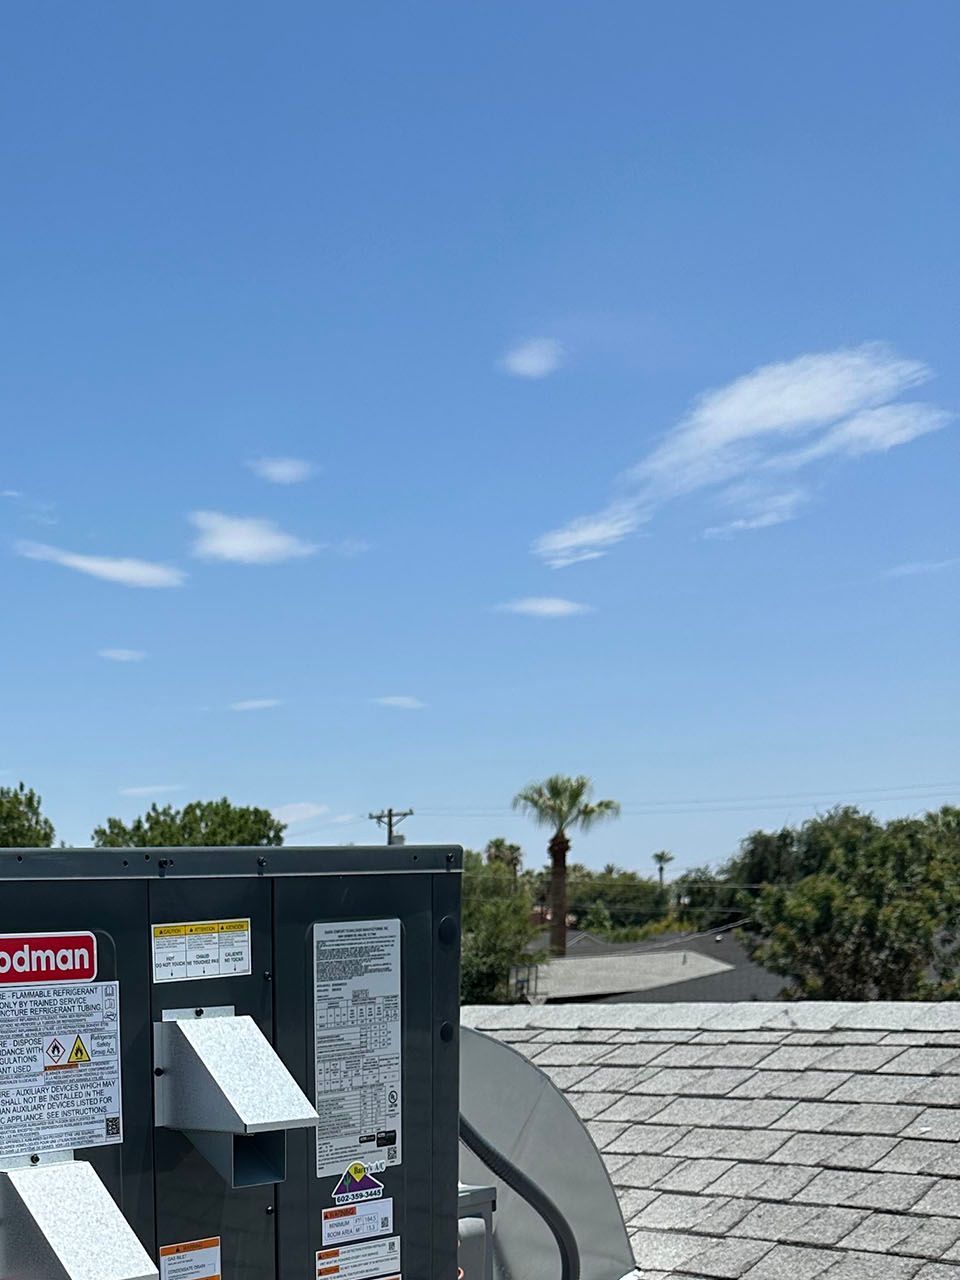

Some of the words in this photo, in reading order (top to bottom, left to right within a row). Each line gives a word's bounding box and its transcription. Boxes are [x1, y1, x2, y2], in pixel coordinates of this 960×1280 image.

[11, 989, 51, 999] FLAMMABLE
[52, 987, 97, 996] REFRIGERANT
[19, 1000, 28, 1008] BY
[30, 998, 58, 1007] TRAINED
[59, 996, 86, 1005] SERVICE
[29, 1005, 75, 1015] REFRIGERANT
[13, 1037, 41, 1047] DISPOSE
[26, 1045, 43, 1054] WITH
[15, 1086, 49, 1096] AUXILIARY
[51, 1083, 78, 1093] DEVICES
[80, 1081, 101, 1090] WHICH
[102, 1080, 115, 1088] MAY
[0, 1097, 21, 1106] SHALL
[23, 1096, 36, 1104] NOT
[49, 1091, 83, 1101] INSTALLED
[92, 1089, 104, 1097] THE
[12, 1103, 46, 1114] AUXILIARY
[47, 1100, 75, 1110] DEVICES
[76, 1097, 97, 1107] LISTED
[99, 1096, 112, 1104] FOR
[337, 1189, 381, 1203] 602-359-3445
